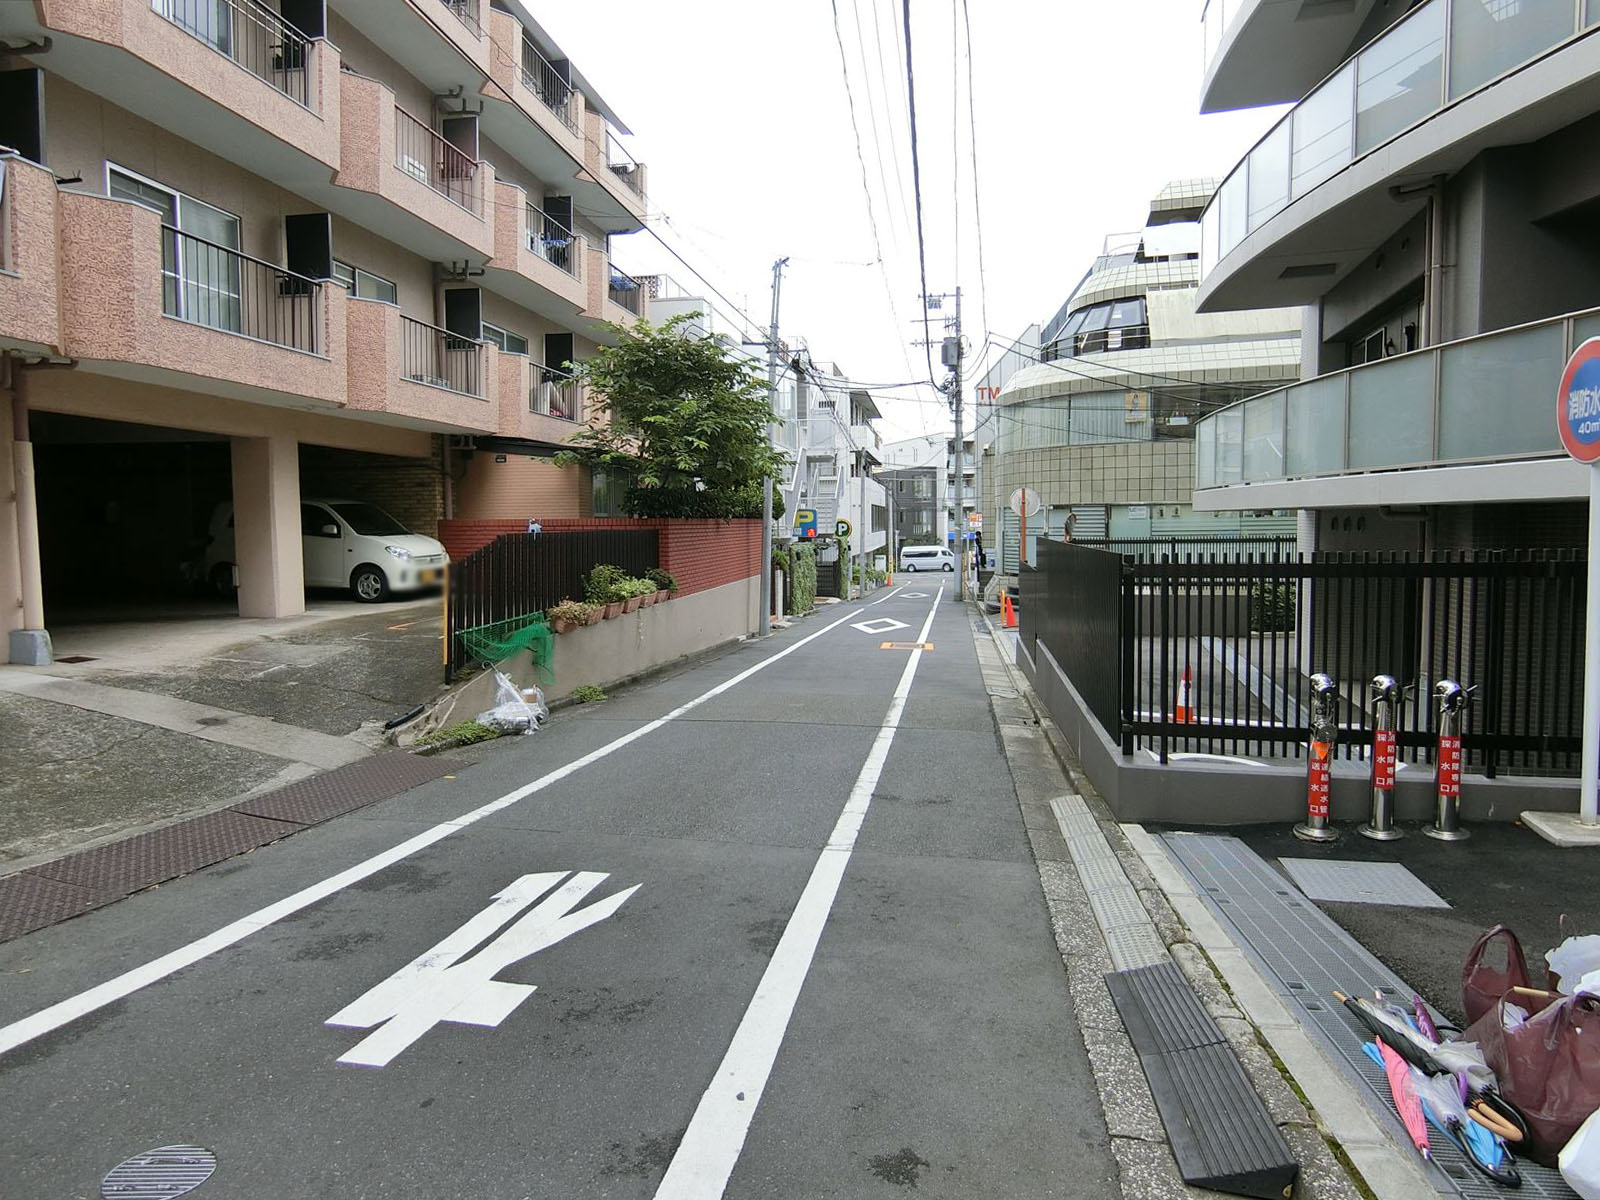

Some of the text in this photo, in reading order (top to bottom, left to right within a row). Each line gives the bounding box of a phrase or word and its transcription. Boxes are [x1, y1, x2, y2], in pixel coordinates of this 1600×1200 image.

[1578, 420, 1600, 435] 40m
[794, 511, 814, 527] P
[838, 523, 848, 535] P
